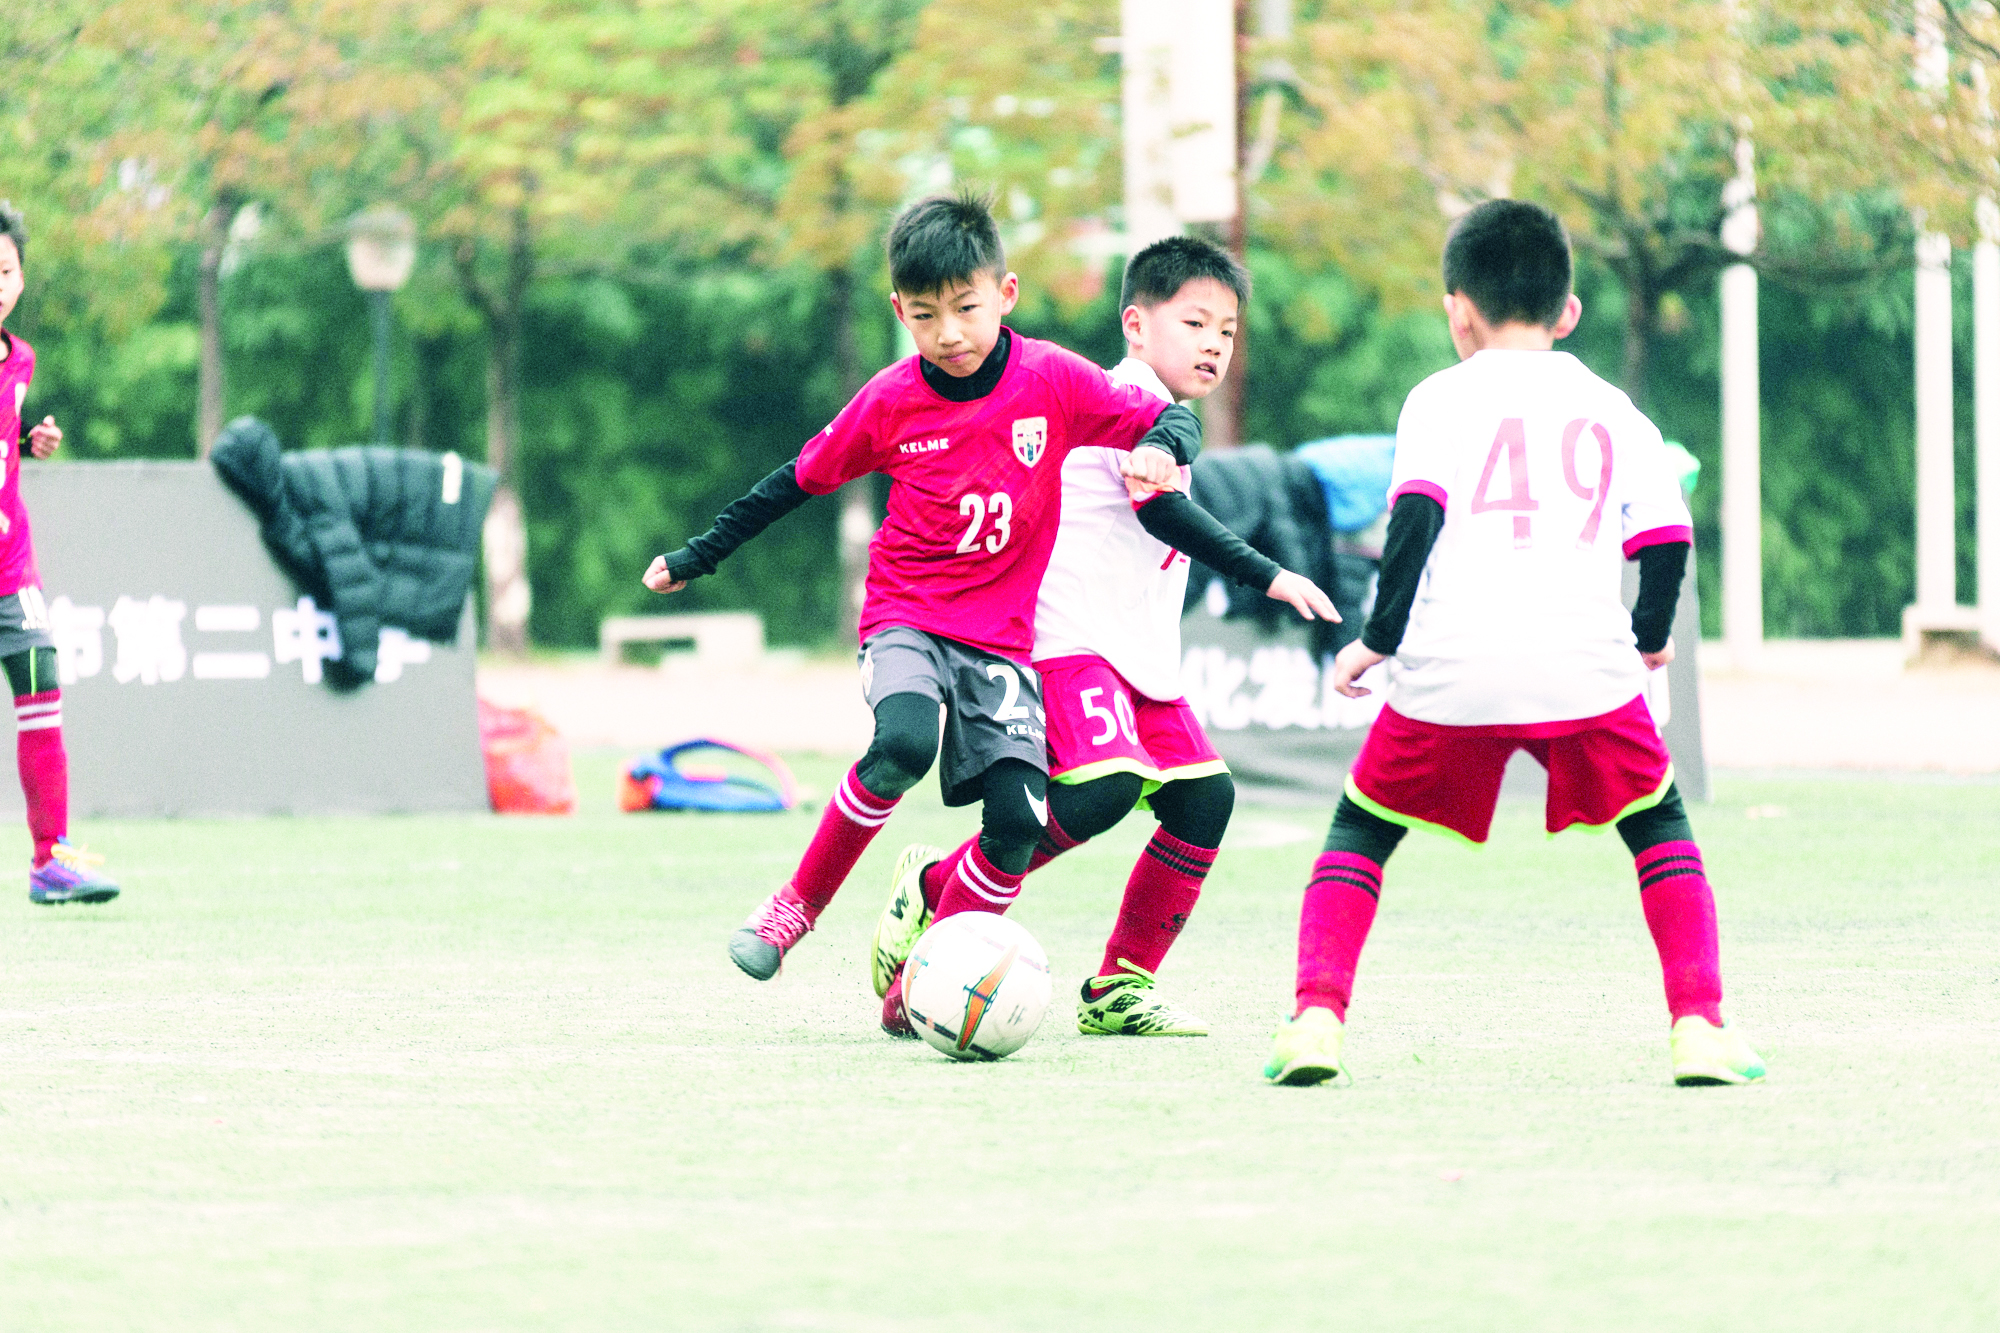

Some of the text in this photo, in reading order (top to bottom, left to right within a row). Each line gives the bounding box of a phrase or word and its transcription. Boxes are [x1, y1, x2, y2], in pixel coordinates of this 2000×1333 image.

[899, 438, 949, 453] KELME
[1471, 417, 1613, 549] 49
[957, 492, 1012, 554] 23
[49, 595, 431, 684] 市第二中
[1079, 686, 1138, 746] 50
